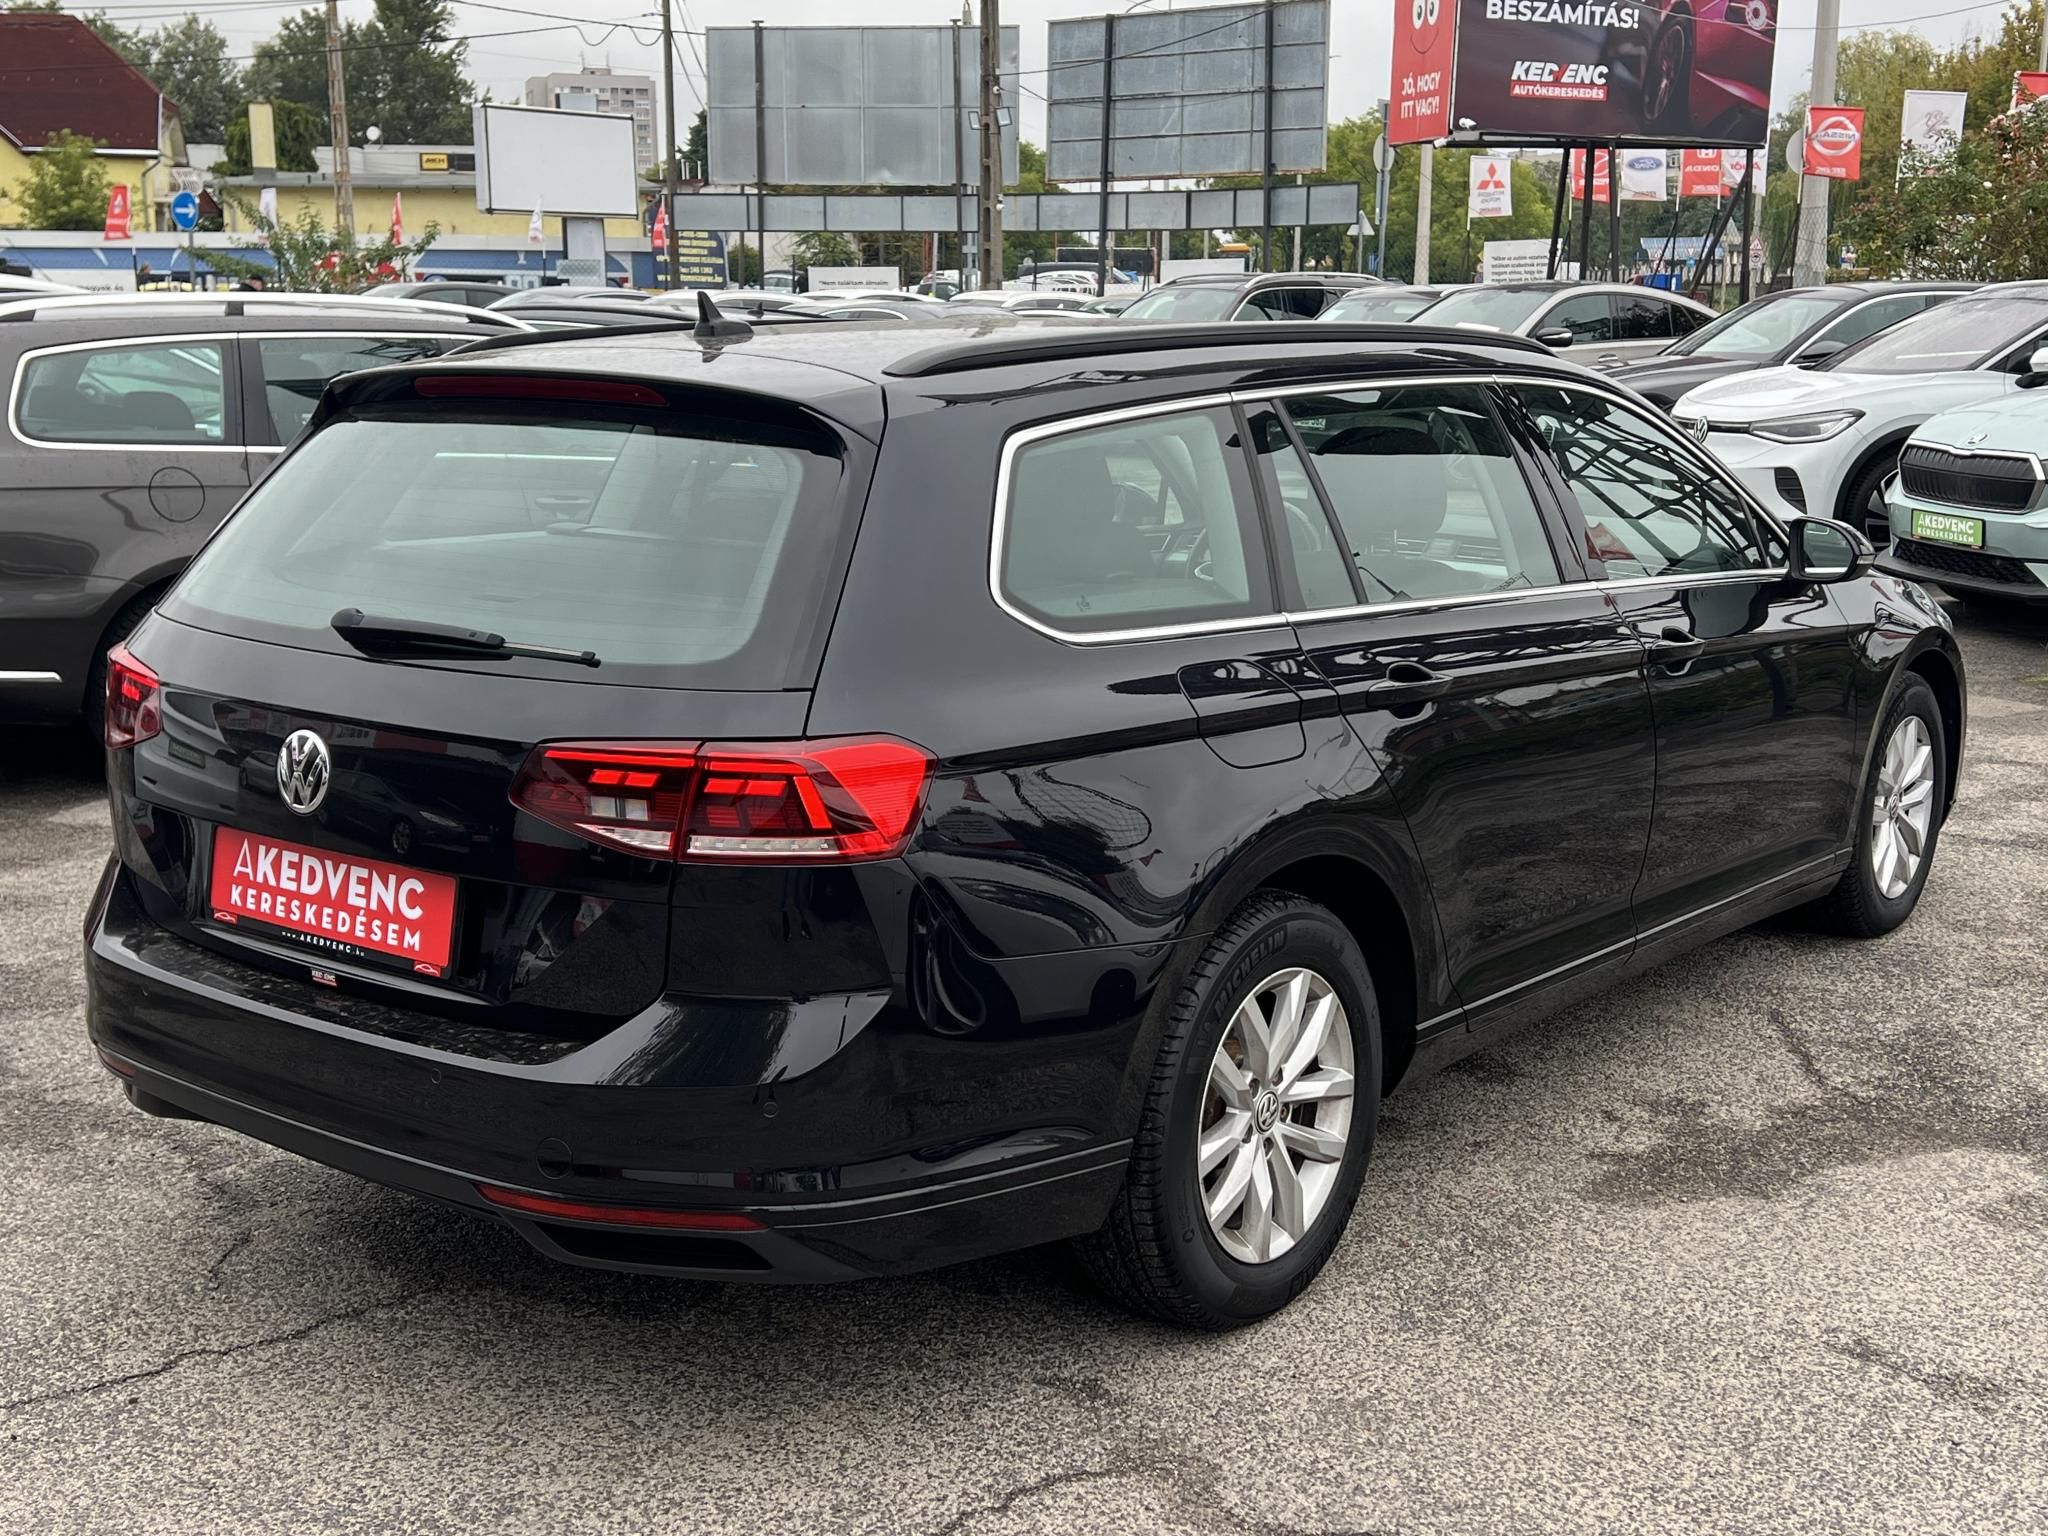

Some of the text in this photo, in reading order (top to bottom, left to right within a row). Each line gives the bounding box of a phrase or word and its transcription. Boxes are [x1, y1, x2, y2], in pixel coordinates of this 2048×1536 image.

[1486, 0, 1639, 29] BESZÁMÍTÁS!
[1402, 72, 1441, 97] JÓ, HOGY
[1513, 84, 1604, 98] AUTÓKERESKEDÉS
[1401, 96, 1440, 119] ITT VAGY!
[230, 884, 421, 952] KERESKEDÉSEM
